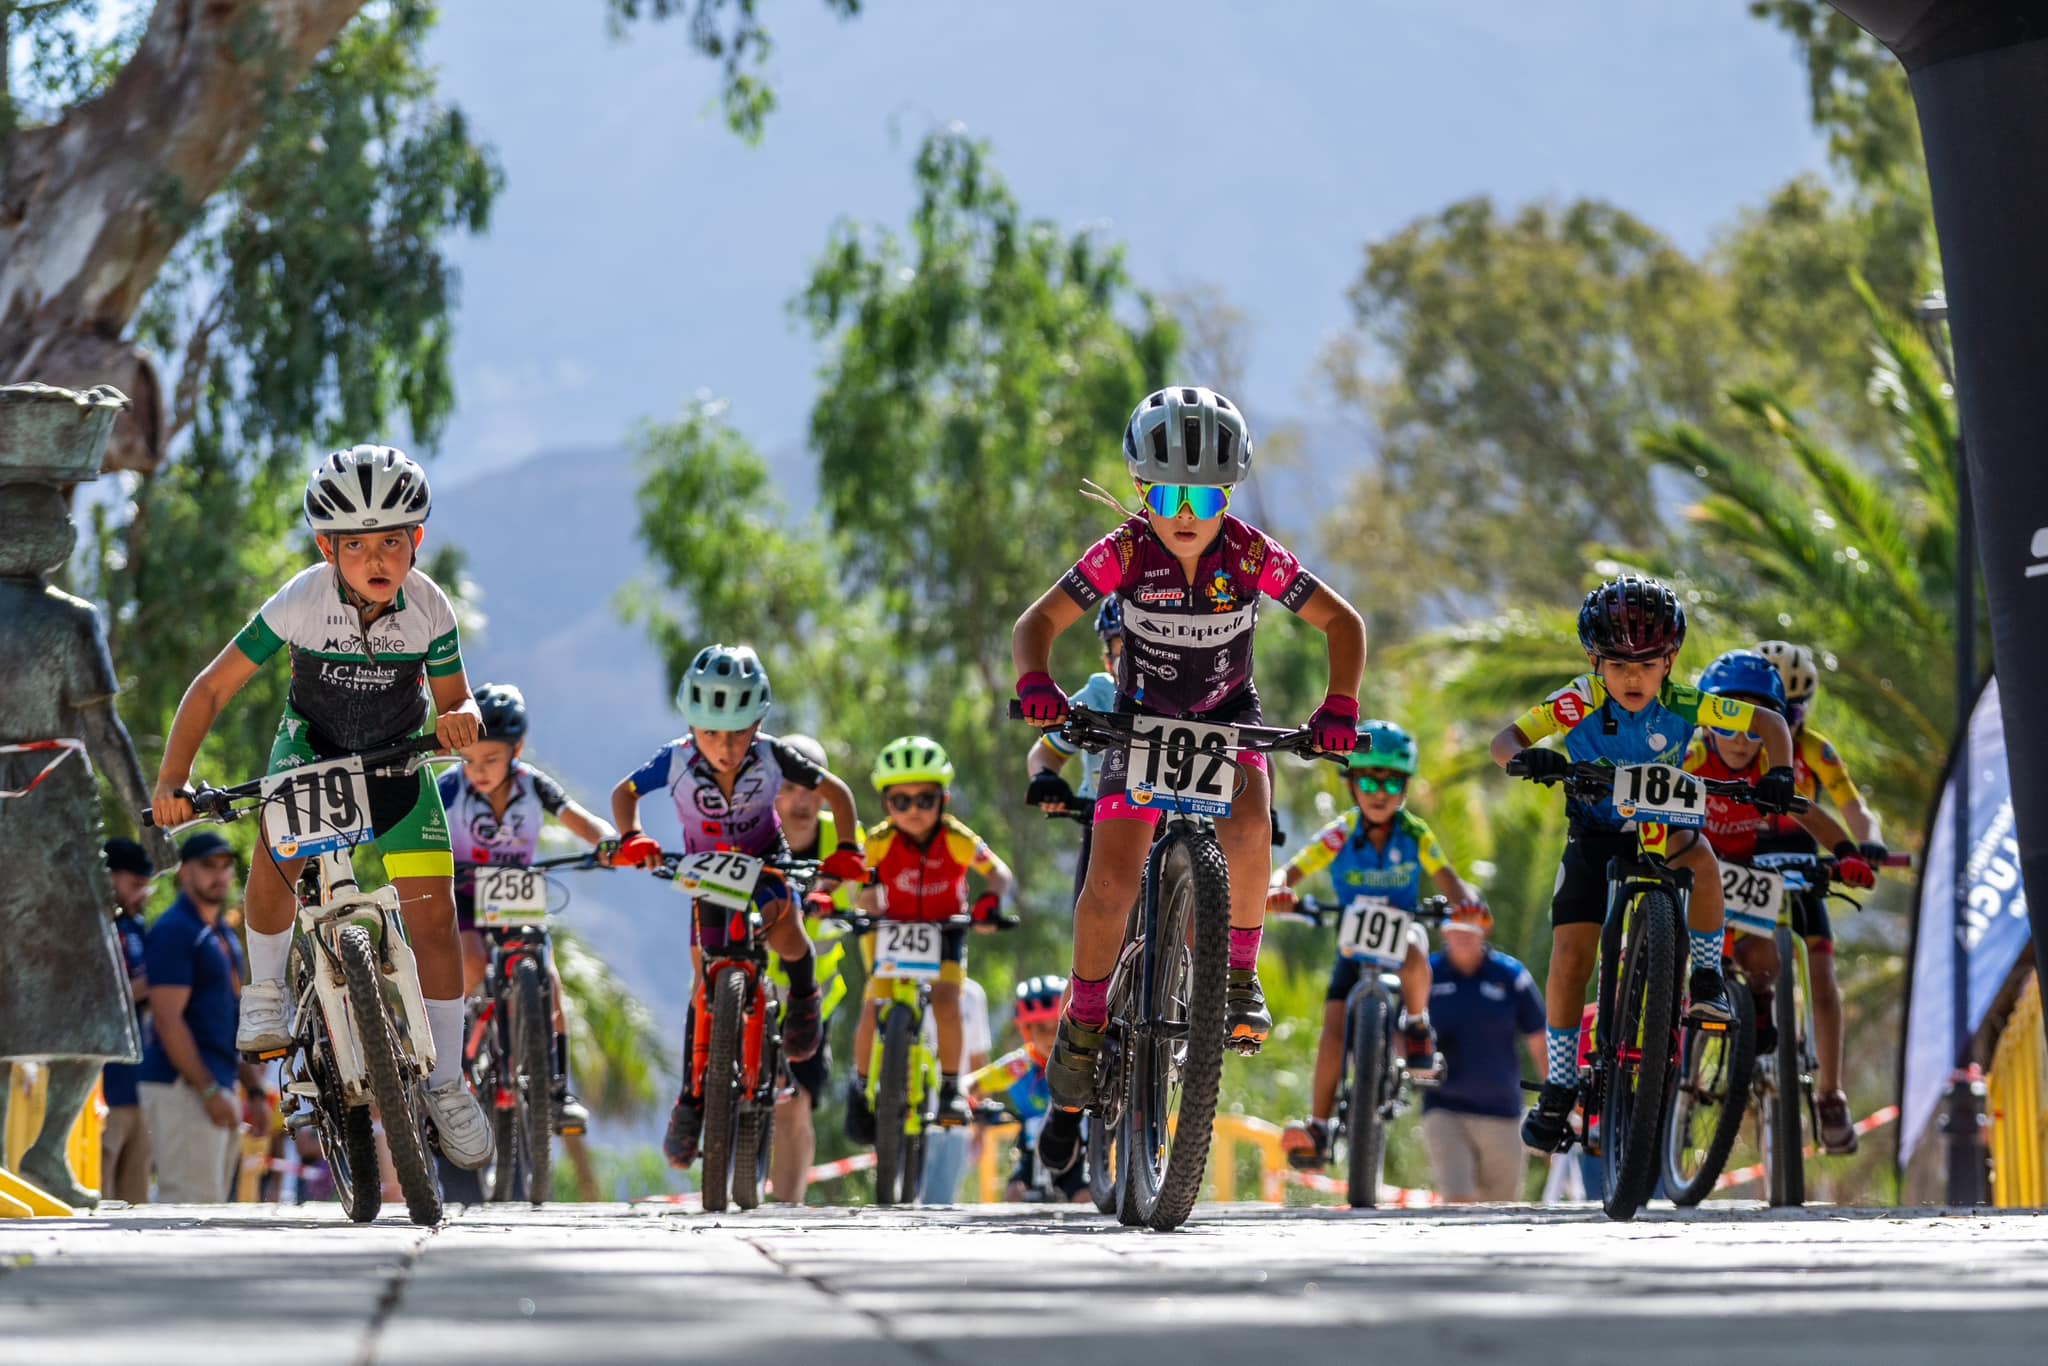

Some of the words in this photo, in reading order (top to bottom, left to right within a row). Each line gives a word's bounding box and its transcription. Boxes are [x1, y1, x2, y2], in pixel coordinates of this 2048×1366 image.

[1144, 568, 1170, 578] FASTER
[1178, 615, 1244, 641] Dipicell
[355, 665, 398, 678] broker
[1142, 725, 1228, 795] 192
[1624, 765, 1698, 809] 184
[273, 767, 357, 837] 179
[1191, 804, 1226, 815] ESCUELAS
[692, 851, 748, 880] 275
[488, 872, 535, 900] 258
[1721, 869, 1772, 908] 243
[887, 925, 930, 953] 245
[1354, 908, 1403, 953] 191
